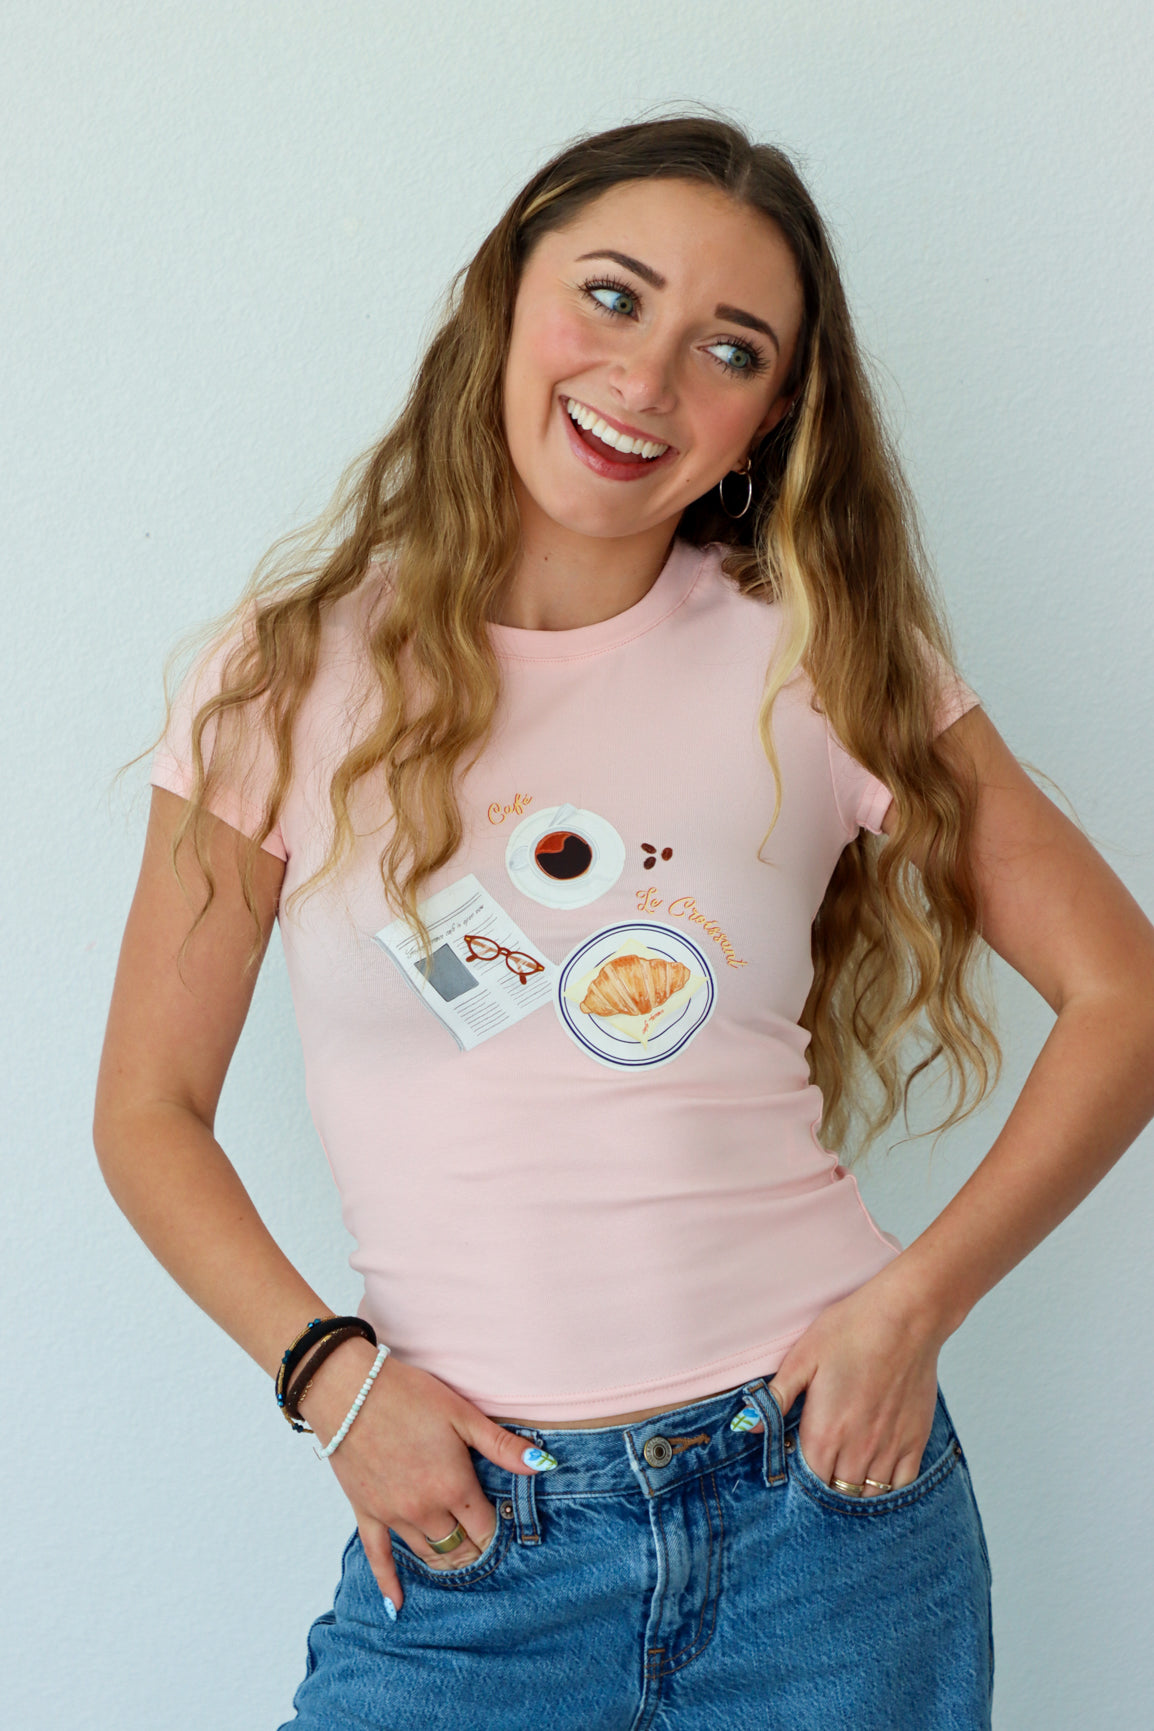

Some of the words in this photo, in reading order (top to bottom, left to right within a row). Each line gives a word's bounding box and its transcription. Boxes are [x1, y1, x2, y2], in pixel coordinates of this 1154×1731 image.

[487, 792, 533, 825] Café
[635, 886, 663, 915] Le
[668, 896, 749, 969] Croissant
